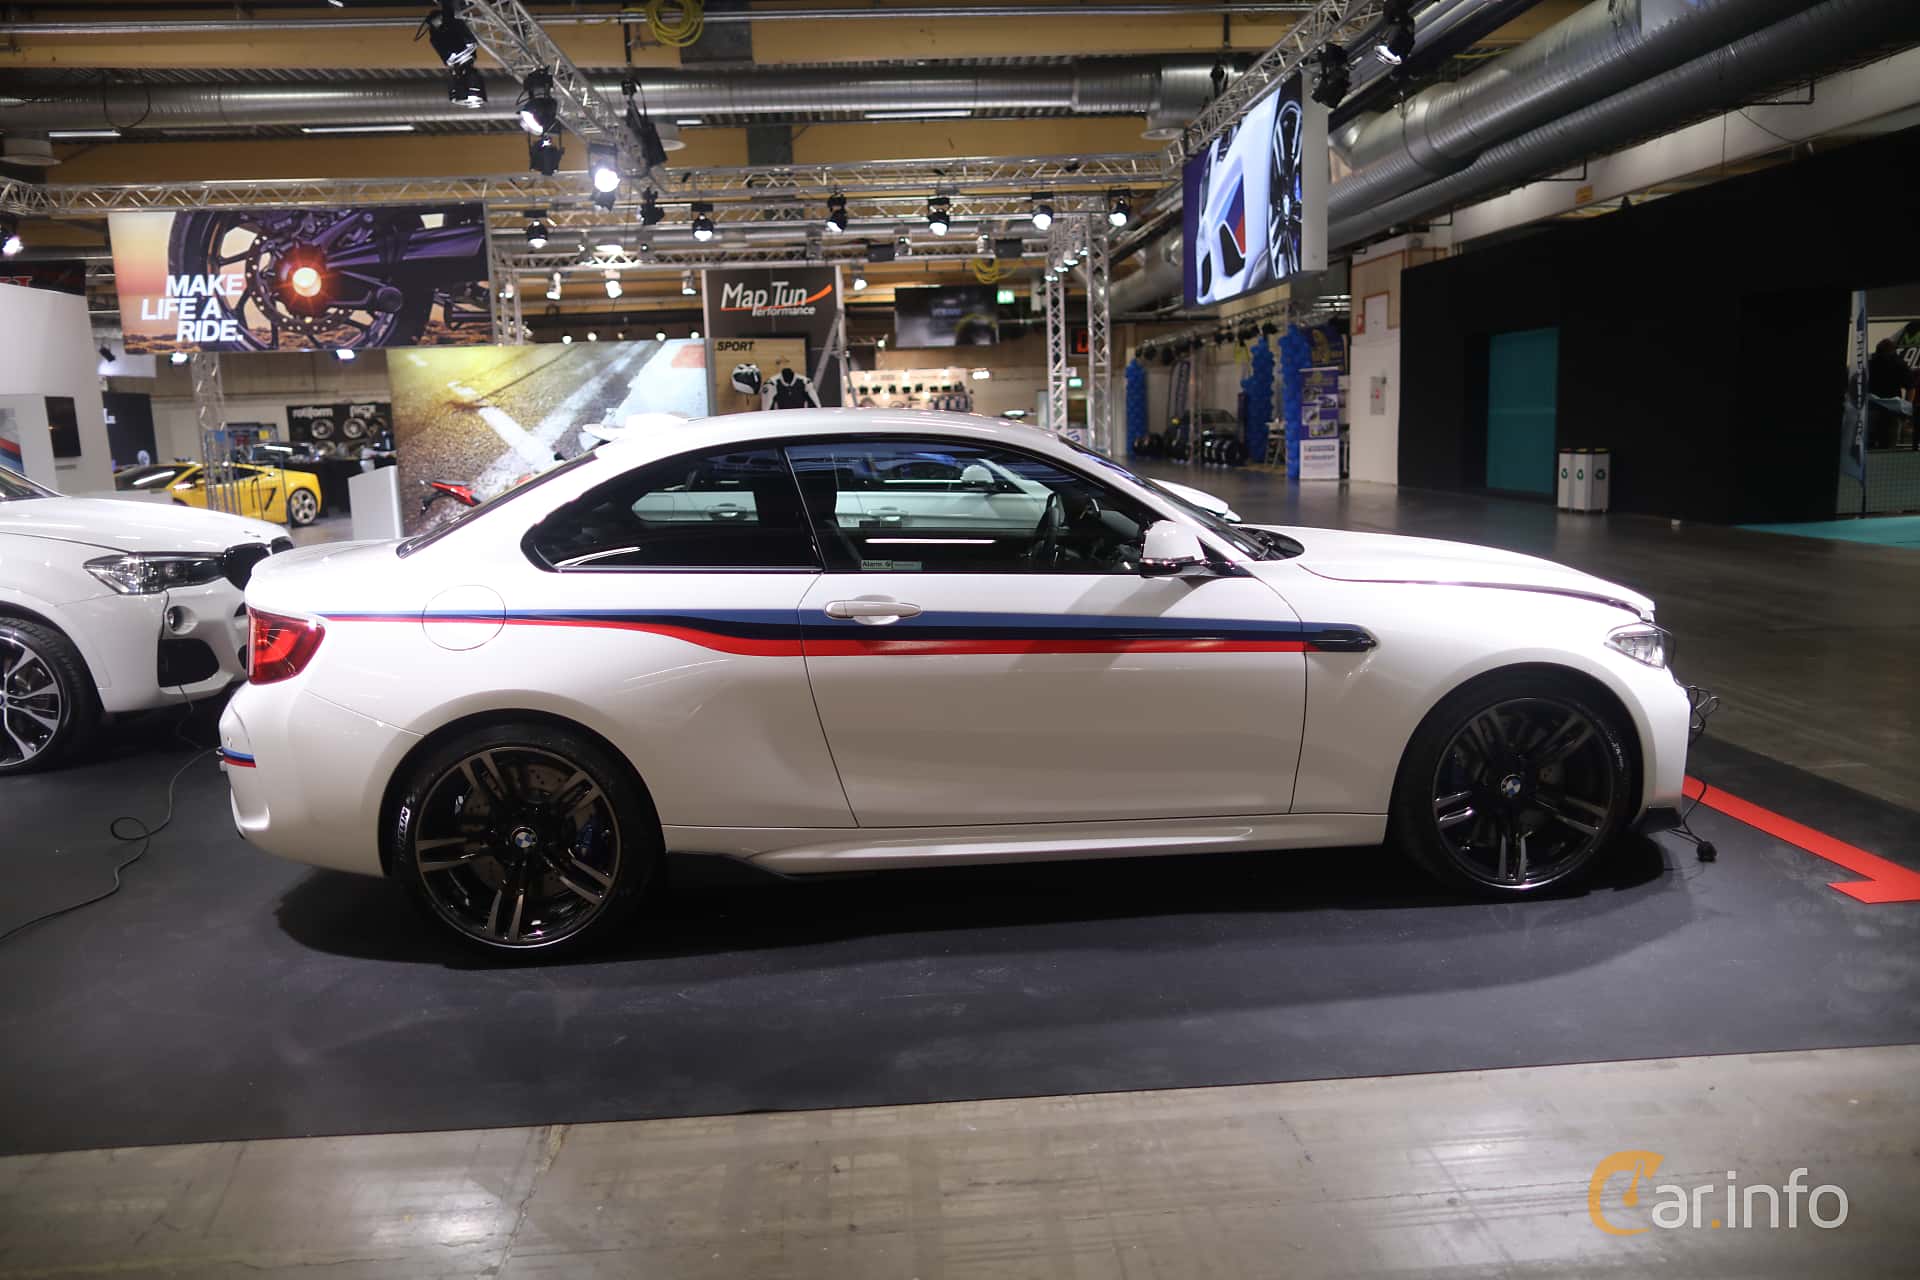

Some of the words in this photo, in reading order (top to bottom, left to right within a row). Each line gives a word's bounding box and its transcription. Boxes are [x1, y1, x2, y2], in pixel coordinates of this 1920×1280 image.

[166, 274, 244, 296] MAKE
[721, 282, 768, 310] Map
[771, 281, 808, 307] Tun
[142, 297, 198, 320] LIFE
[201, 297, 222, 319] A
[176, 320, 244, 343] RIDE.
[717, 341, 755, 352] SPORT
